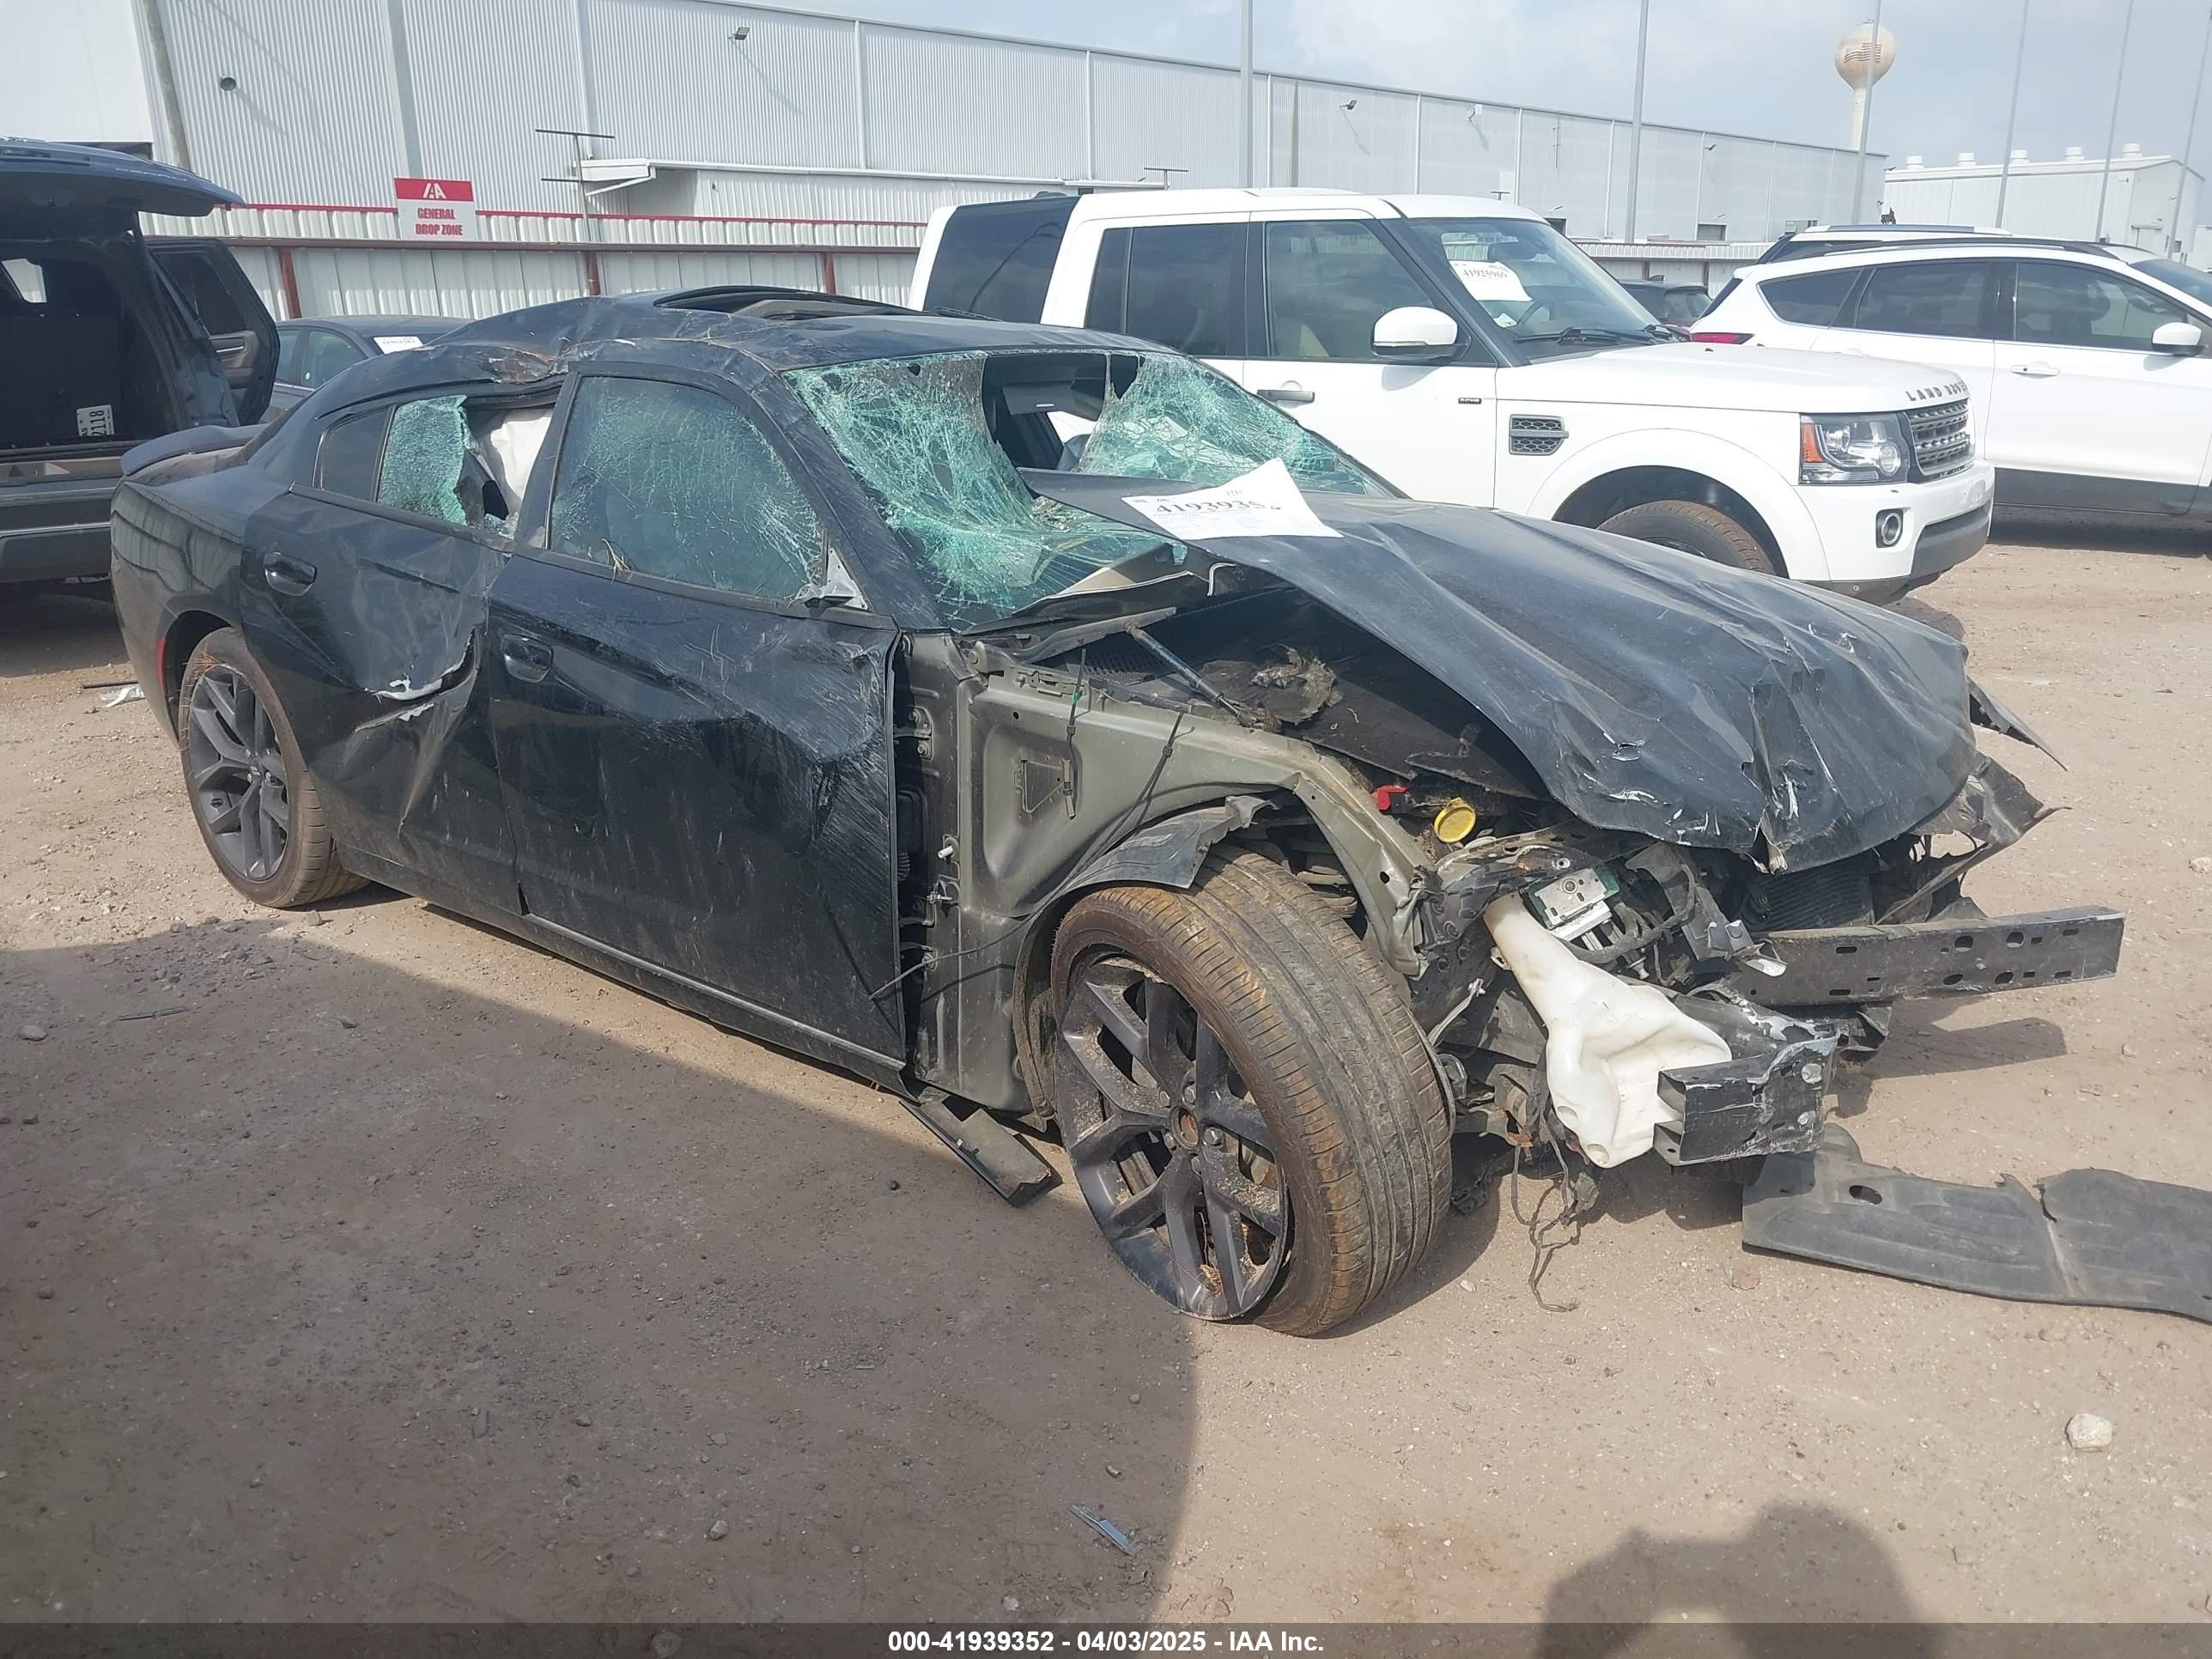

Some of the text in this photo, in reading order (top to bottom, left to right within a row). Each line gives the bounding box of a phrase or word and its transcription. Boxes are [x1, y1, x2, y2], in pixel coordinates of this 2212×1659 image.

[417, 208, 455, 220] GENERAL
[416, 224, 464, 235] DROP ZONE
[1905, 387, 1942, 401] LAND
